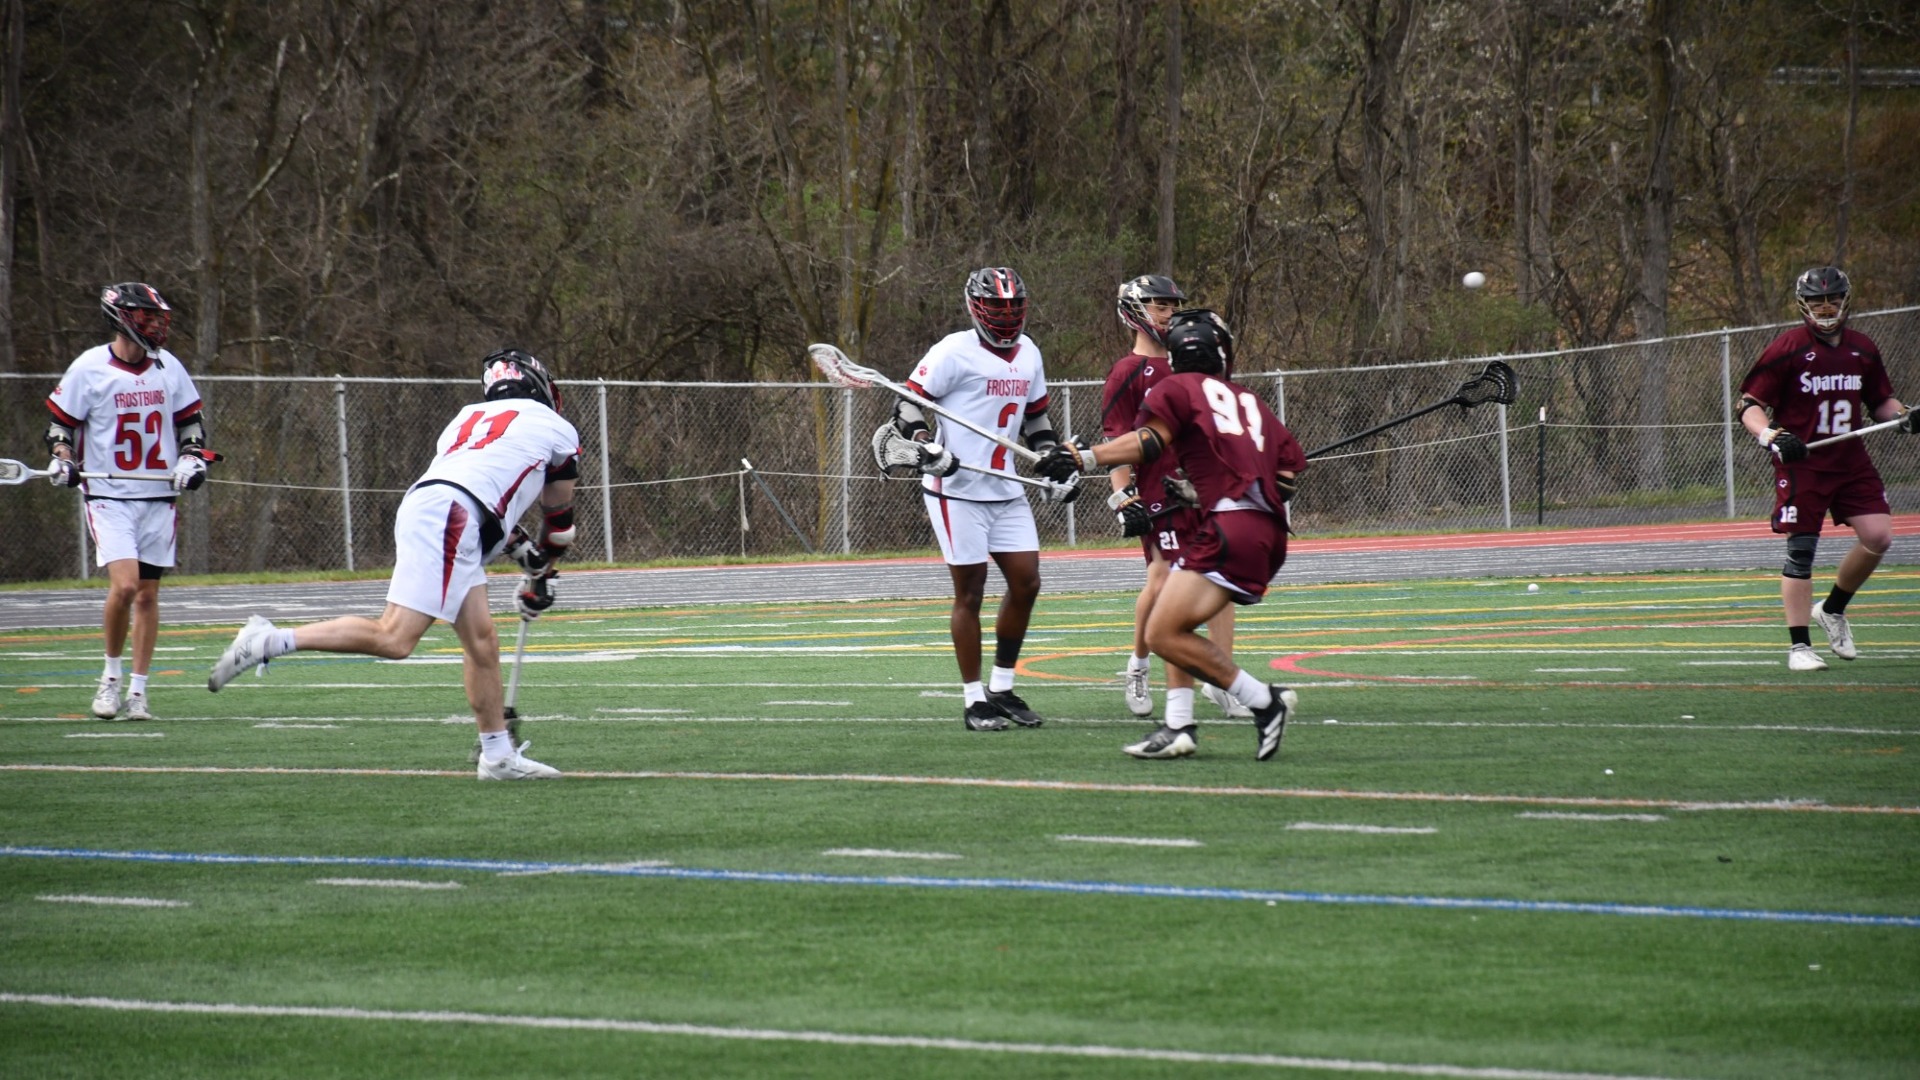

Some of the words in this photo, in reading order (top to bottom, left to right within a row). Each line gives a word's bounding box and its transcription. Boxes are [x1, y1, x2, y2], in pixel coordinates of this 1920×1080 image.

[1800, 371, 1862, 396] Spartans
[114, 389, 165, 409] FROSTBURG
[1202, 377, 1265, 452] 91
[1816, 399, 1852, 435] 12
[114, 410, 168, 472] 52
[1780, 505, 1798, 524] 12
[1159, 530, 1180, 550] 21
